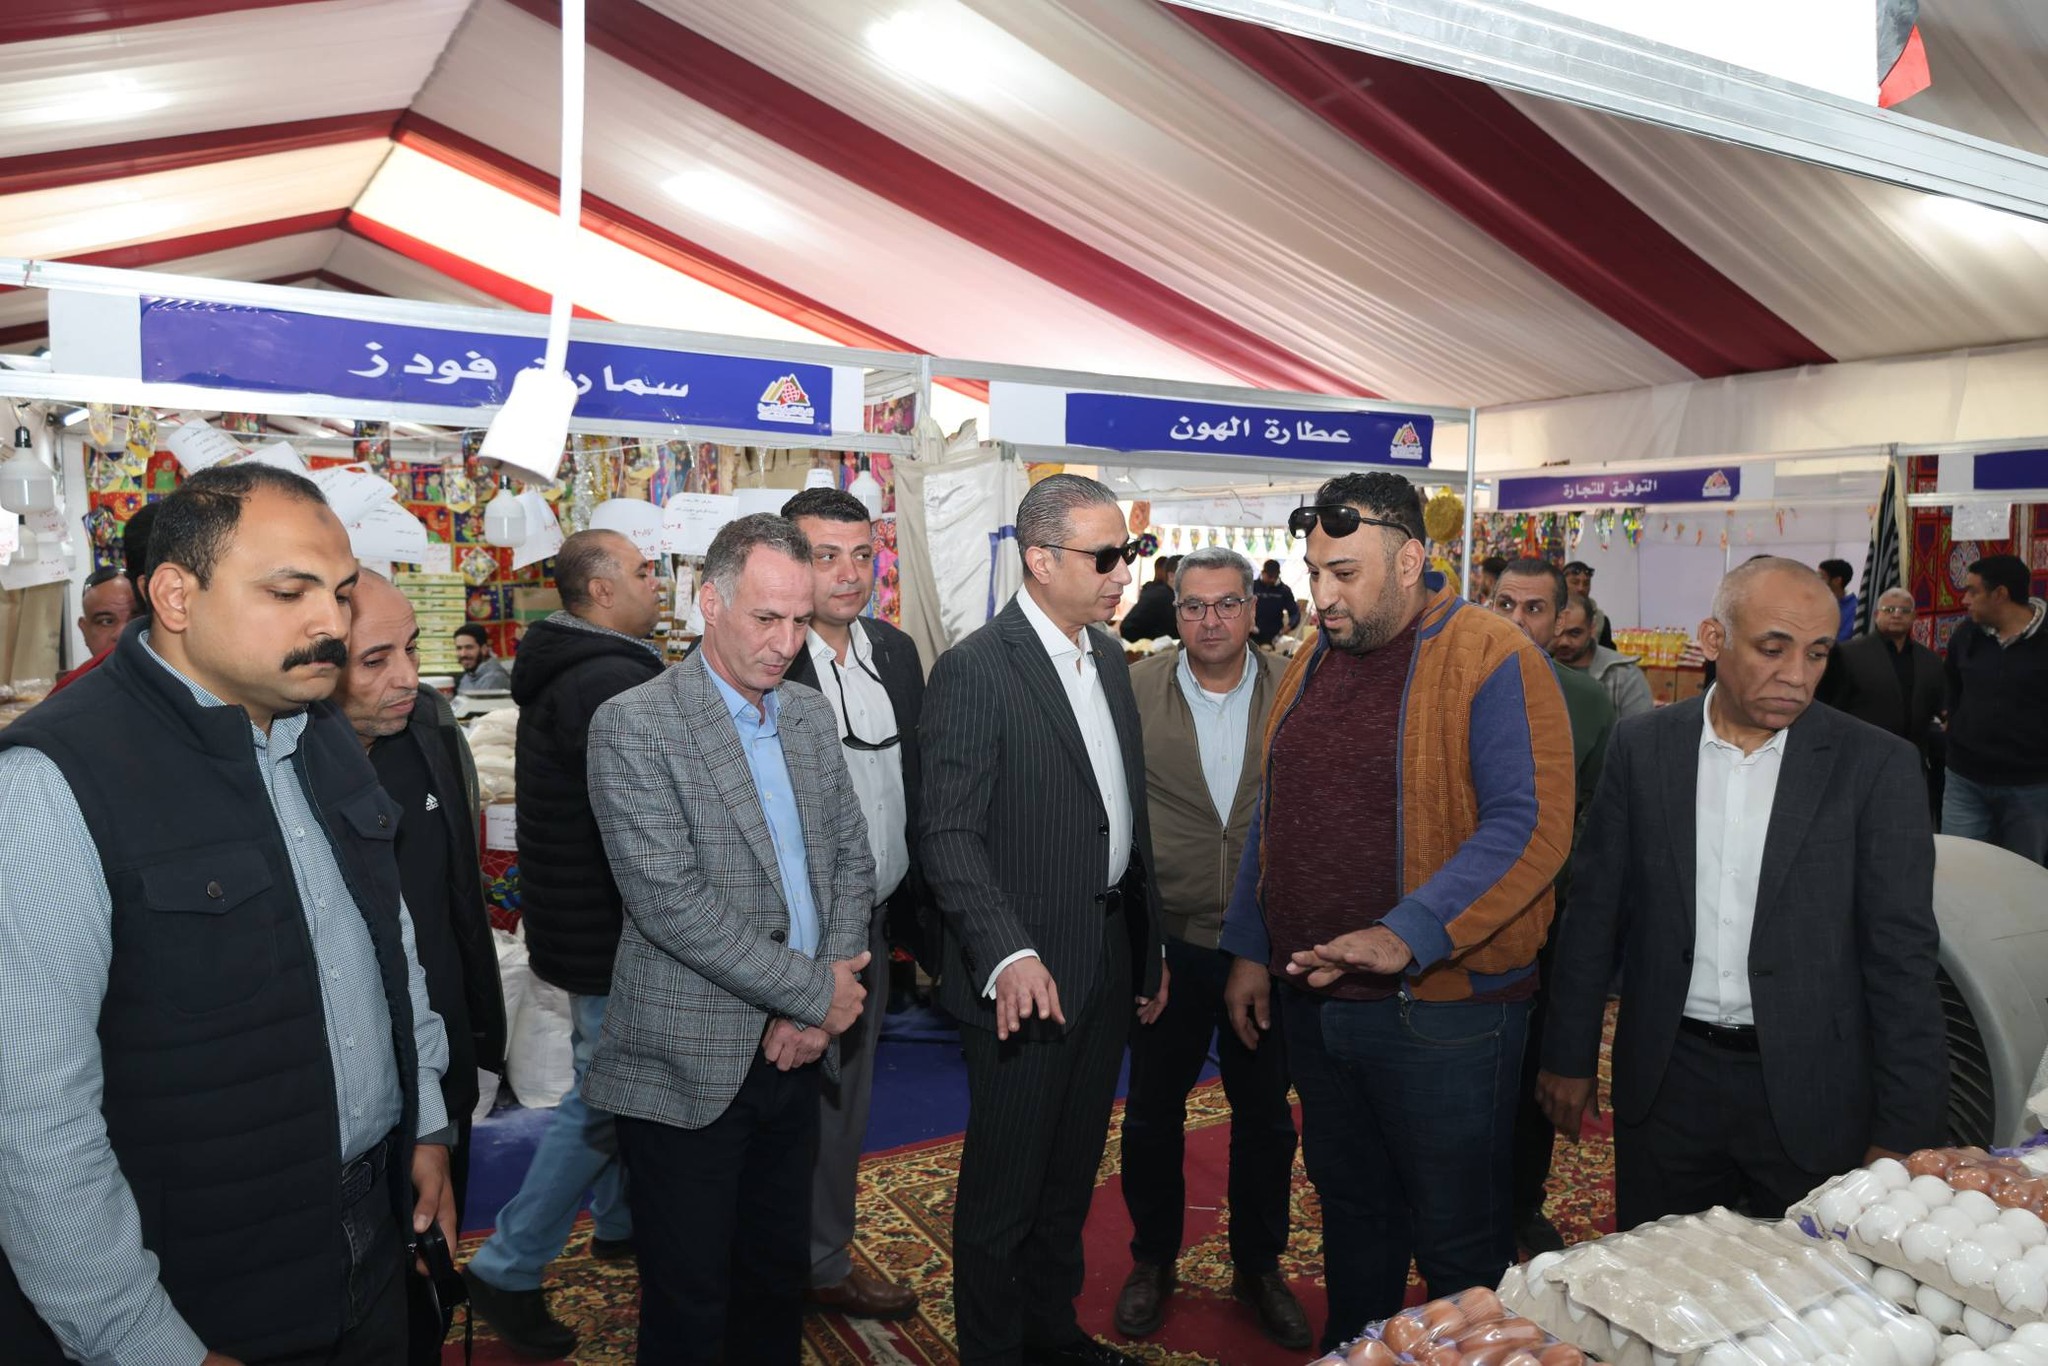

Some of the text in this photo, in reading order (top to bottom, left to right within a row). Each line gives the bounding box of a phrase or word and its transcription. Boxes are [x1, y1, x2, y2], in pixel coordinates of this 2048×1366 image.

[1169, 415, 1352, 445] عطارة الهون
[1562, 479, 1658, 499] التوفيق للتجارة
